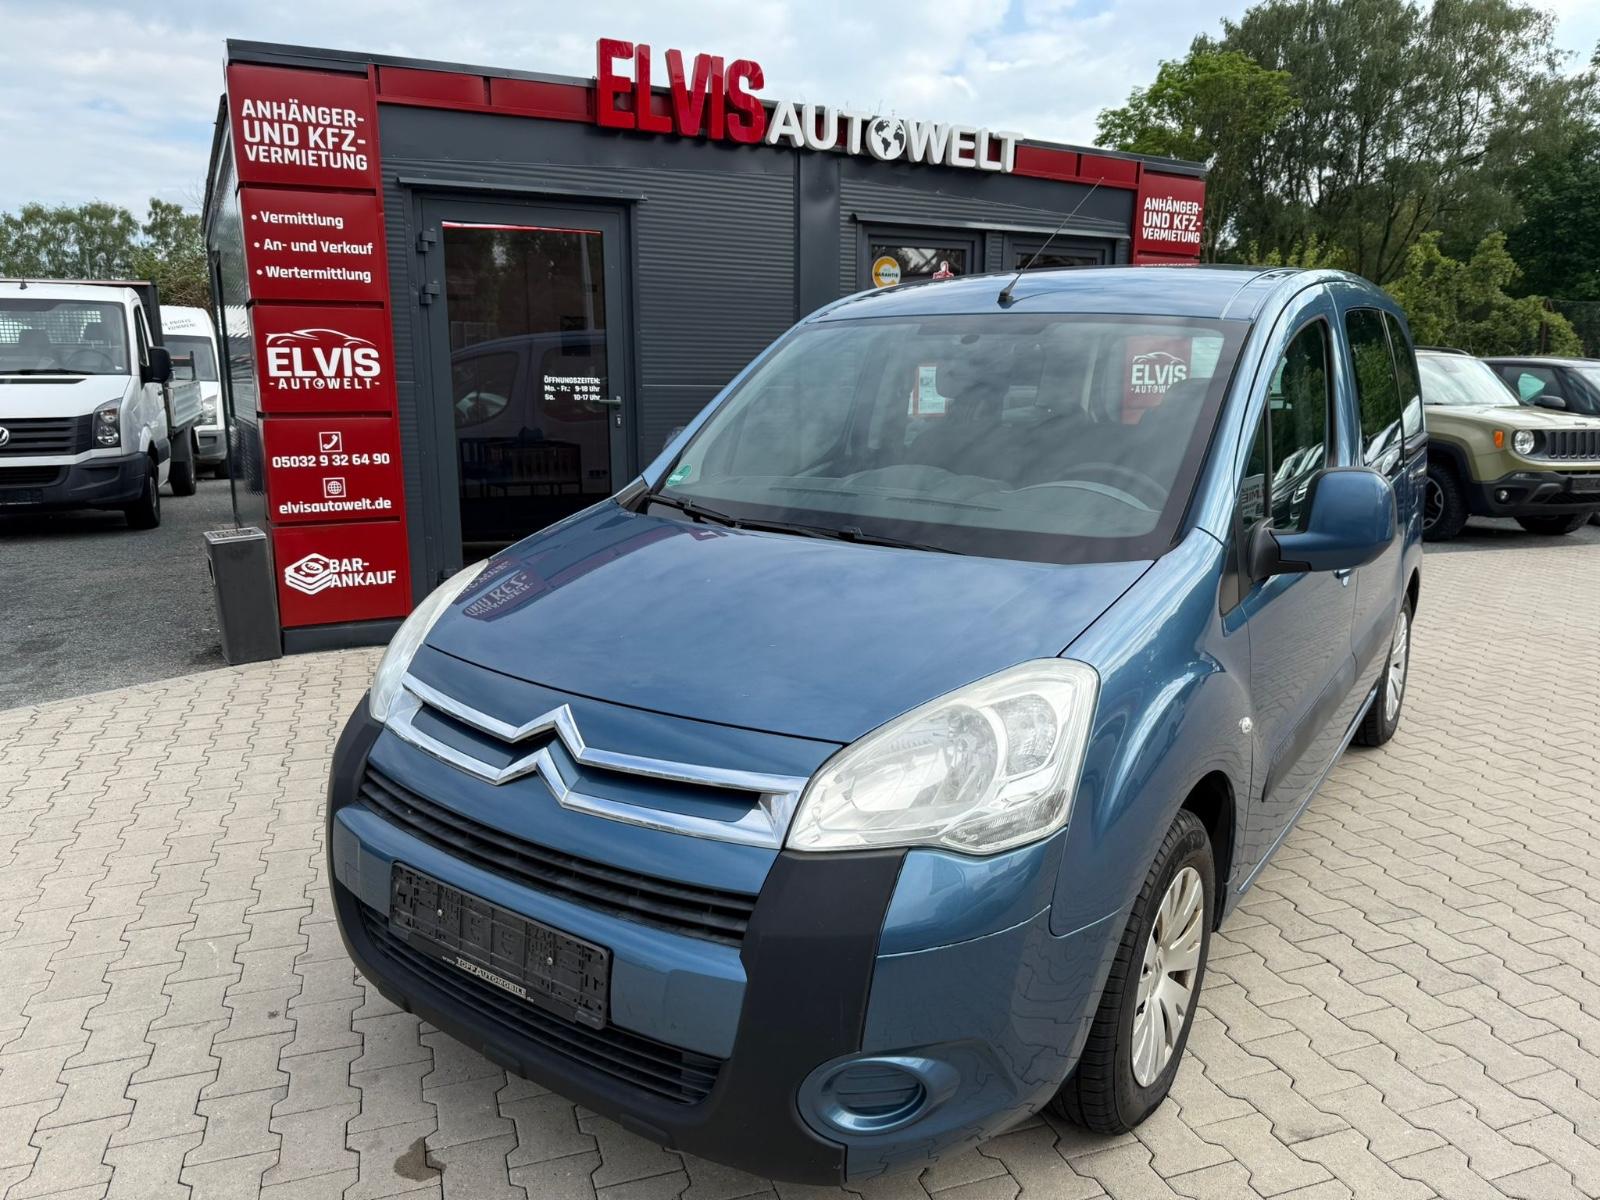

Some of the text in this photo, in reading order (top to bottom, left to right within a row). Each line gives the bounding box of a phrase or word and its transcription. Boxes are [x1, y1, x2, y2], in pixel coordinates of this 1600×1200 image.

[597, 38, 765, 144] ELVIS
[241, 99, 364, 127] ANHÄNGER-
[243, 120, 365, 151] UND KFZ-
[244, 145, 367, 170] VERMIETUNG
[1144, 196, 1202, 215] ANHÄNGER-
[260, 211, 344, 229] Vermittlung
[1143, 211, 1201, 230] UND KFZ-
[1142, 227, 1200, 243] VERMIETUNG
[263, 238, 373, 255] An- und Verkauf
[265, 265, 371, 283] Wertermittlung
[266, 347, 381, 377] ELVIS
[544, 375, 600, 384] ÖFFNUNGSZEITEN:
[1131, 364, 1187, 385] ELVIS
[273, 453, 390, 468] 05032 9 32 64 90
[279, 497, 392, 515] elvisautowelt.de
[330, 558, 370, 573] BAR-
[331, 570, 397, 588] ANKAUF
